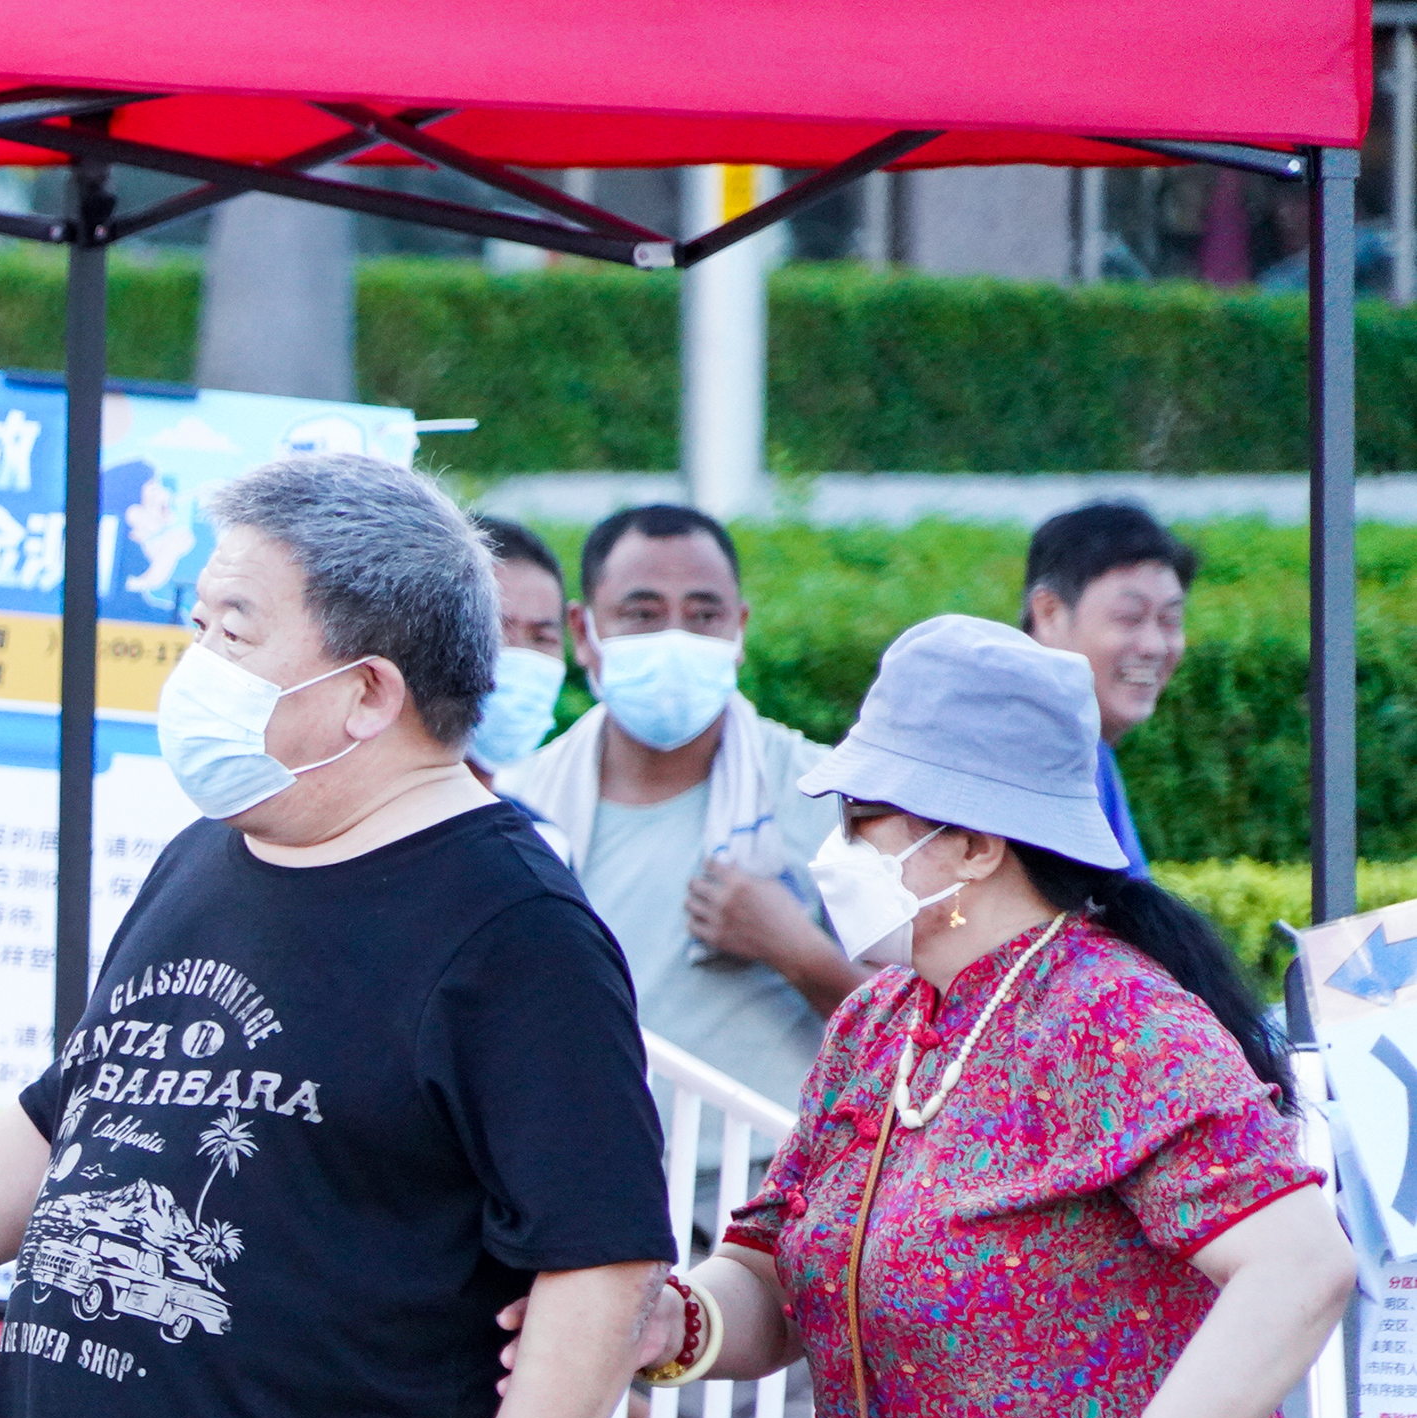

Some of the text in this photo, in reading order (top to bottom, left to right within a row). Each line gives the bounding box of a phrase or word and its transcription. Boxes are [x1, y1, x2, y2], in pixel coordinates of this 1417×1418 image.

[61, 1020, 173, 1072] ANTA
[91, 1063, 323, 1124] BARBARA
[1388, 1276, 1417, 1290] 分区
